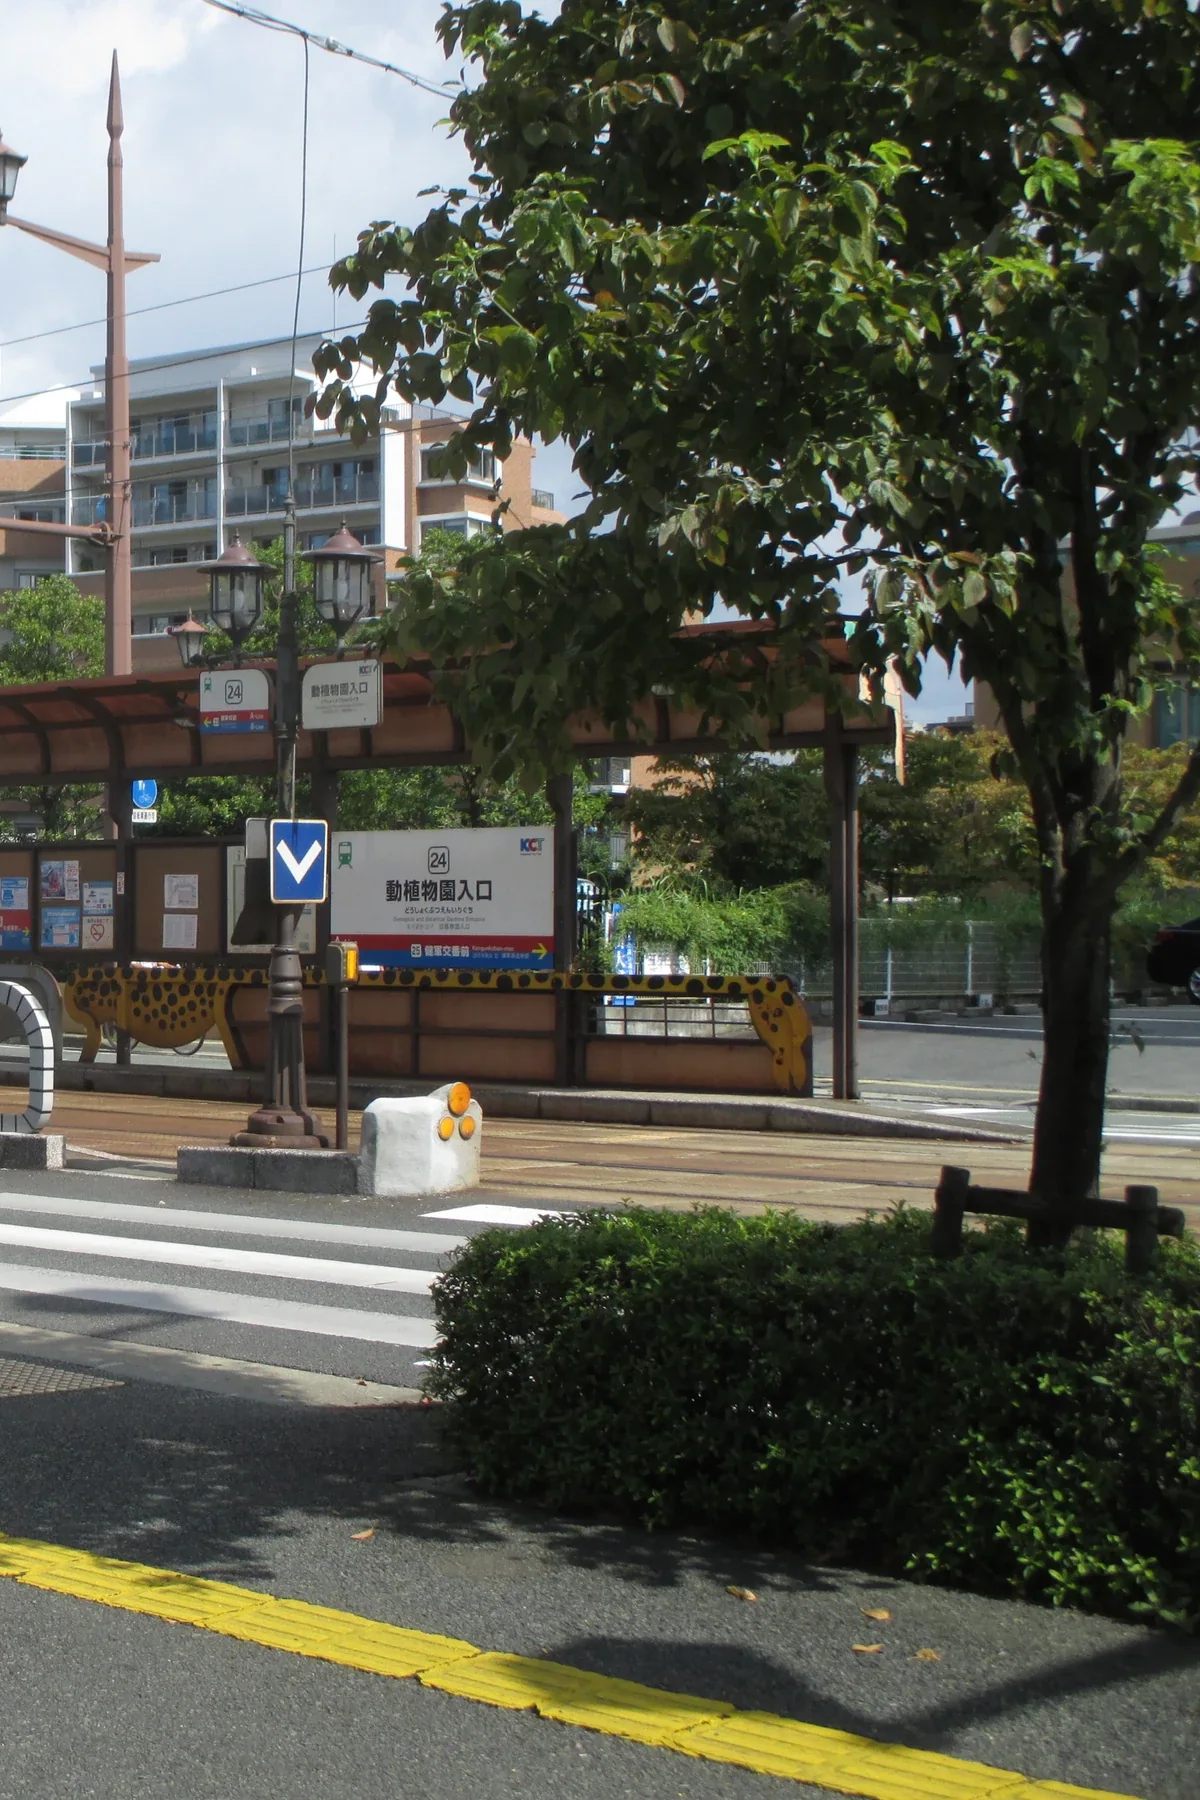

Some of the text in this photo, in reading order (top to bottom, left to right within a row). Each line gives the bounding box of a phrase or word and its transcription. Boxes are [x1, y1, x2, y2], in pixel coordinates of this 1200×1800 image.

[227, 686, 241, 700] 24
[311, 682, 368, 698] 動植物園入口
[520, 837, 545, 852] KCT
[430, 853, 447, 868] 24
[385, 879, 493, 902] 動植物園入口
[424, 945, 470, 957] 健軍交番前
